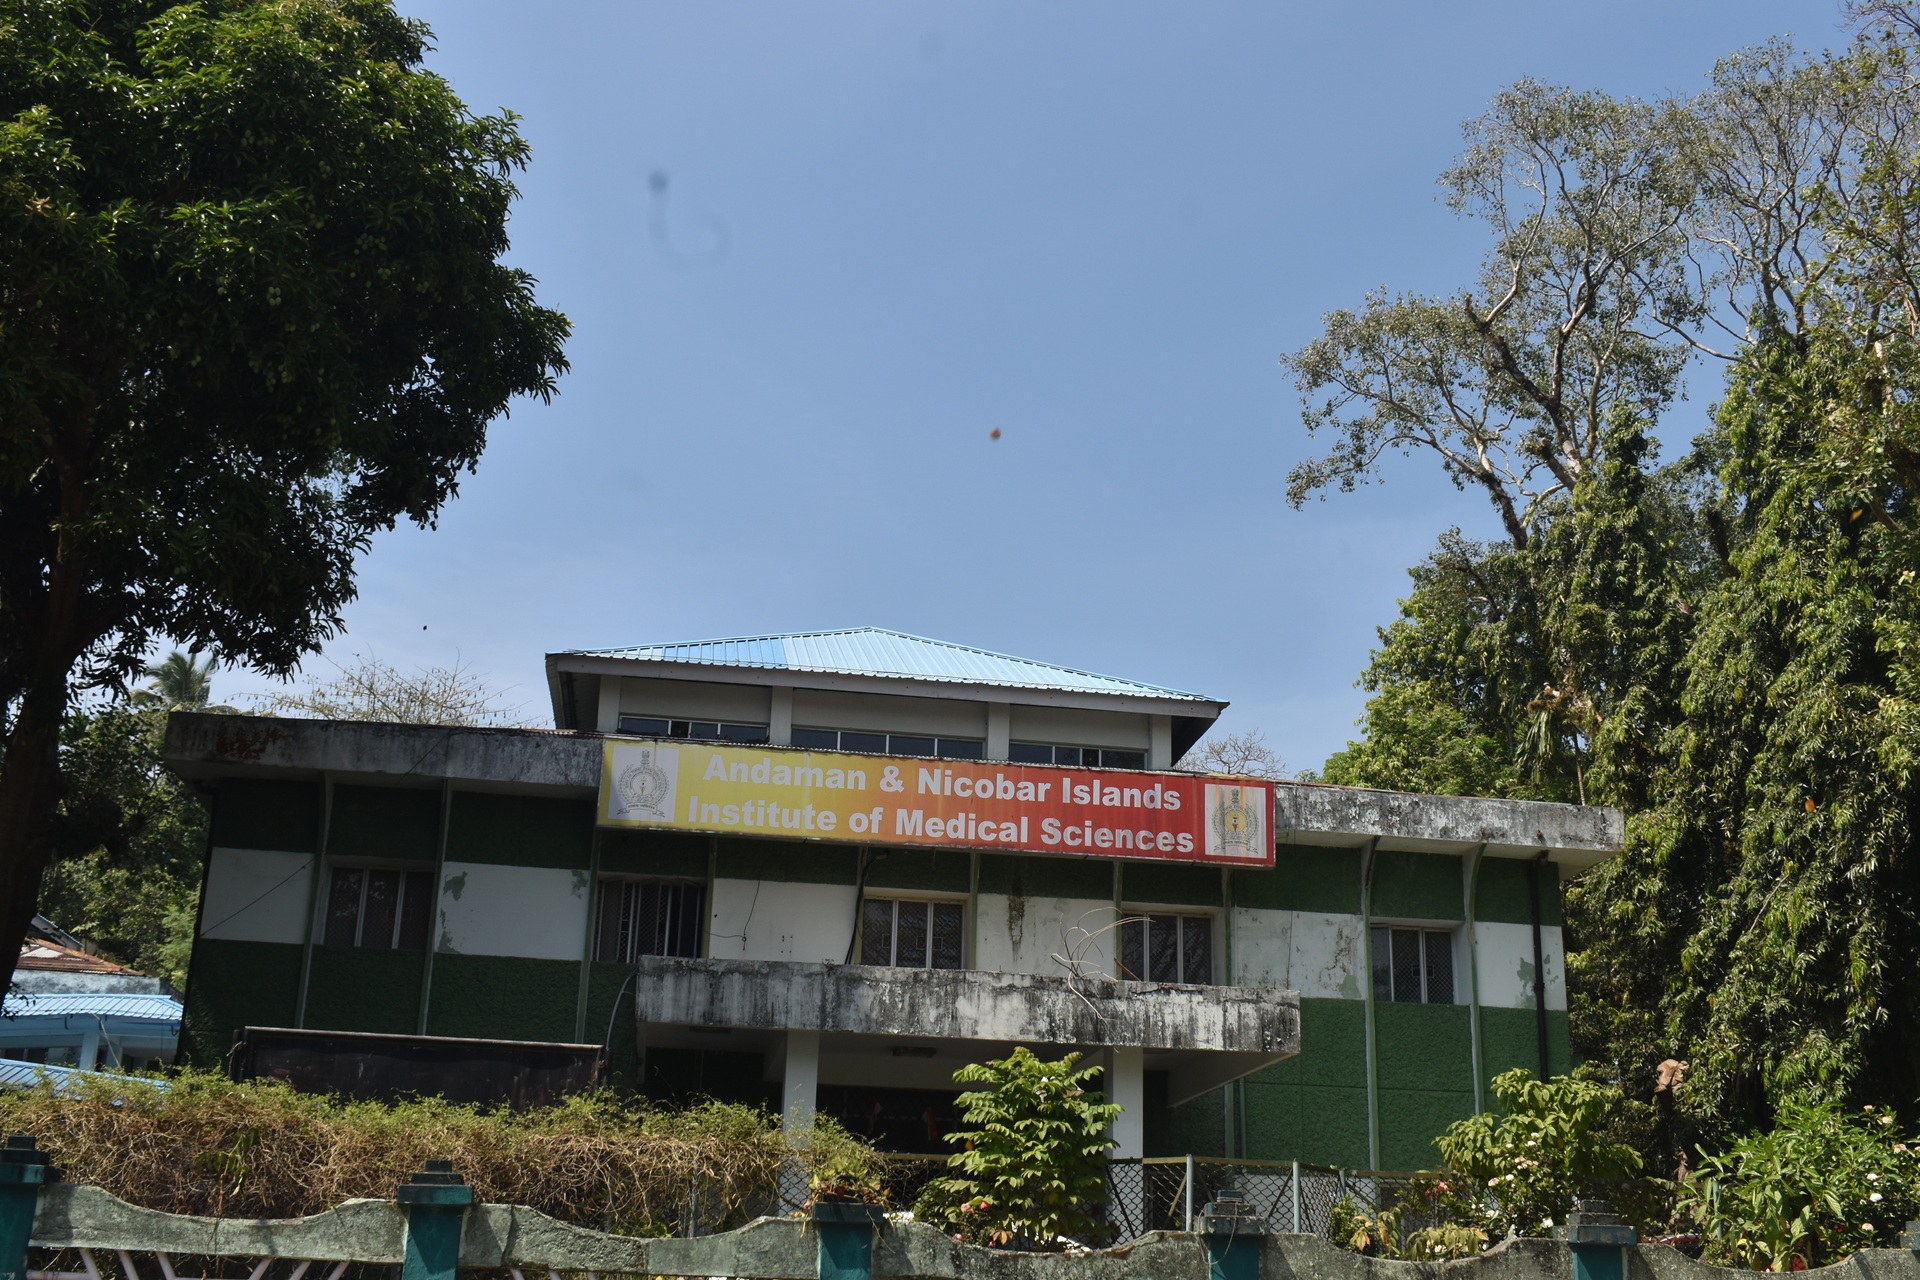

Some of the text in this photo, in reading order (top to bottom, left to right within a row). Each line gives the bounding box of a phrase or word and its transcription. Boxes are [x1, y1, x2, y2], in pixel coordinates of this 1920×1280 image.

[703, 754, 866, 790] Andaman
[879, 765, 905, 793] &
[918, 767, 1052, 803] Nicobar
[1062, 777, 1181, 811] Islands
[688, 795, 1195, 853] Institute of Medical Sciences
